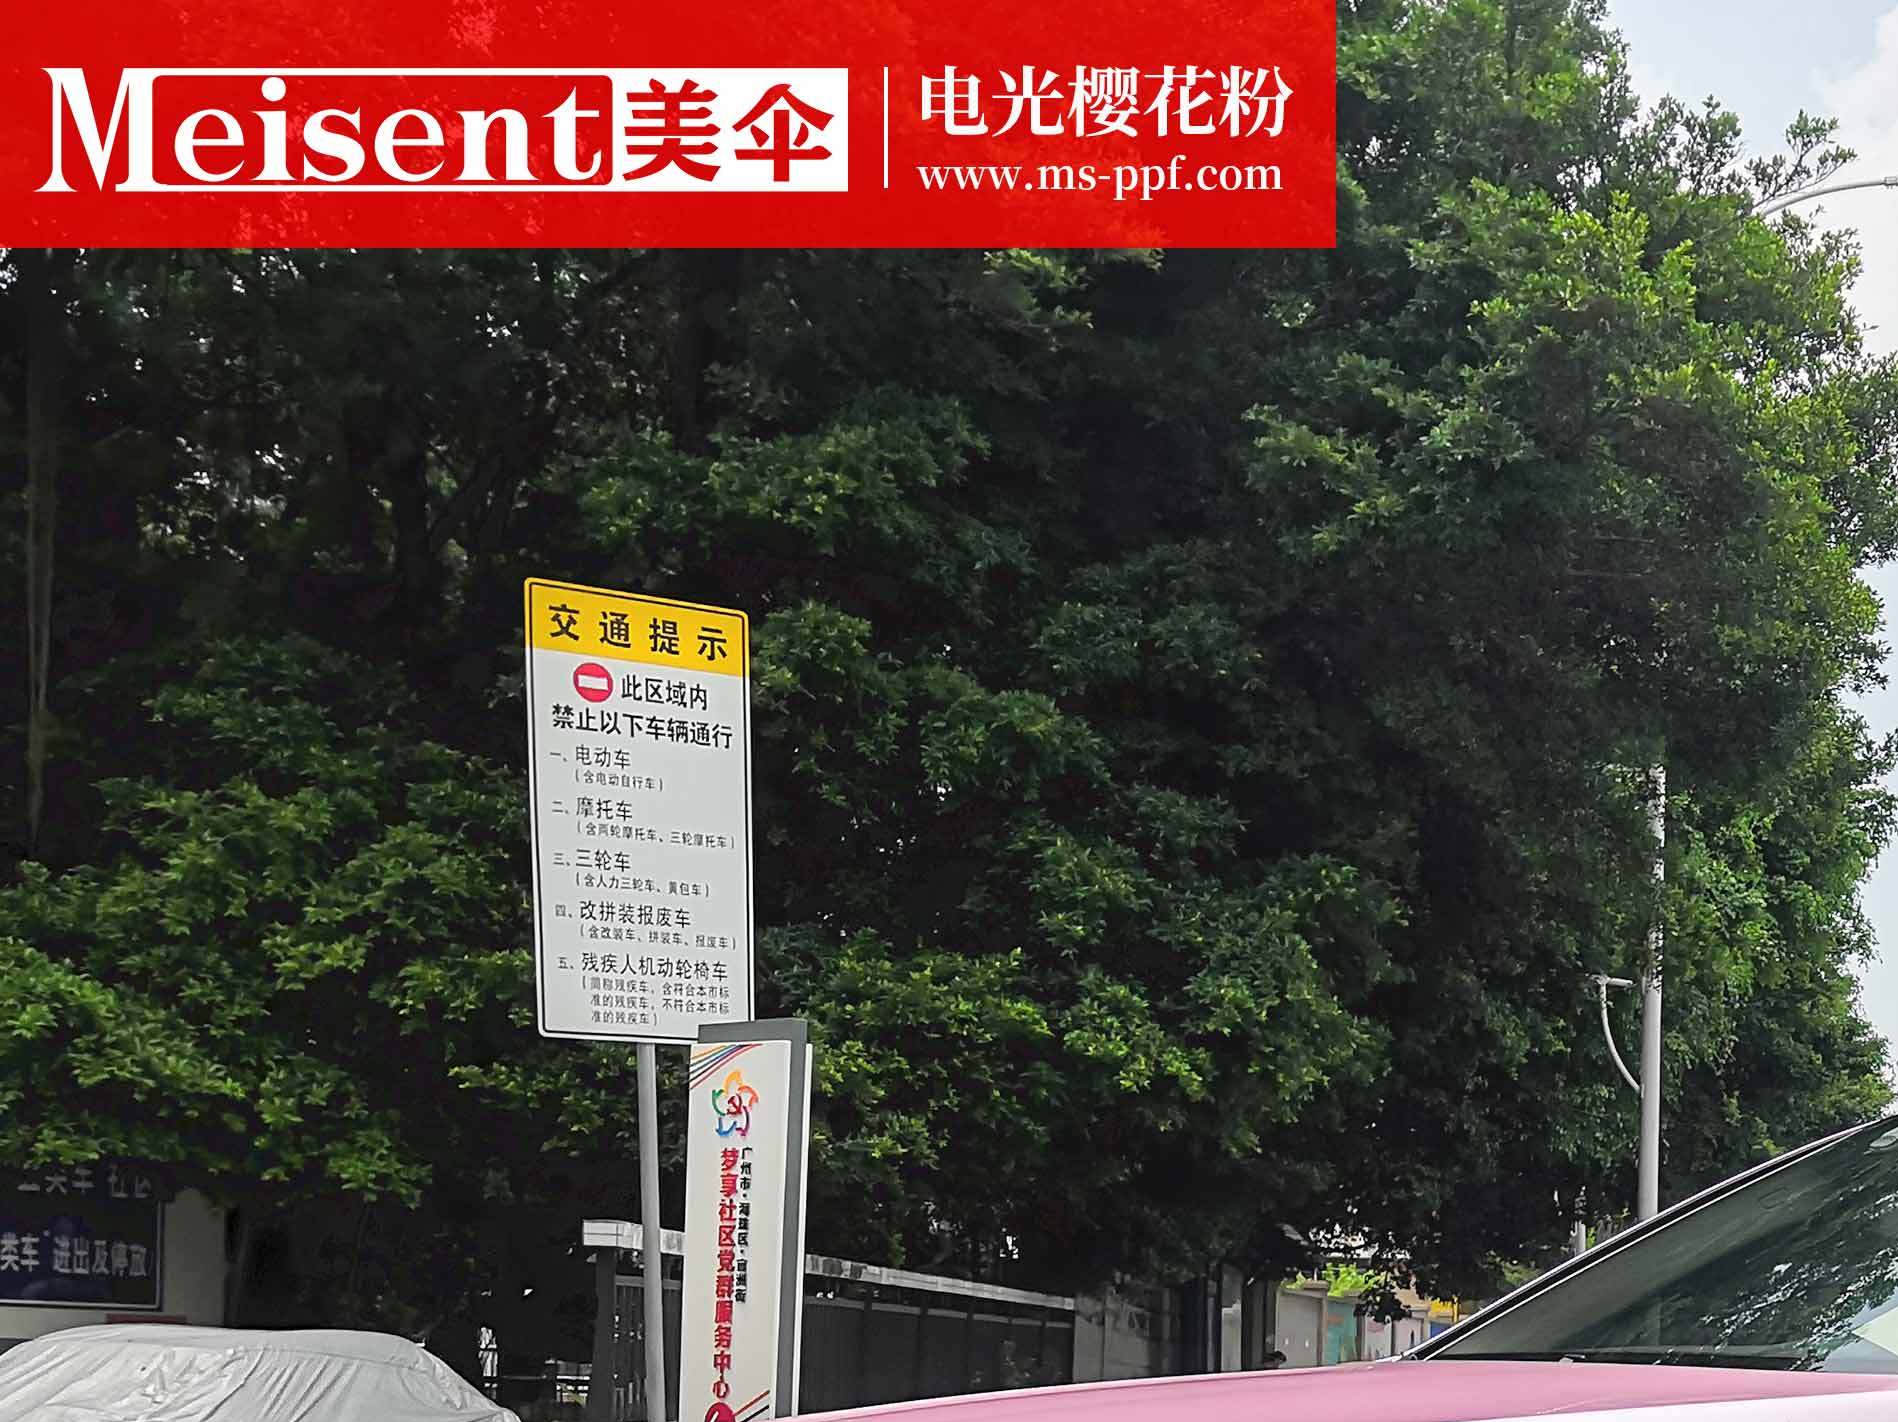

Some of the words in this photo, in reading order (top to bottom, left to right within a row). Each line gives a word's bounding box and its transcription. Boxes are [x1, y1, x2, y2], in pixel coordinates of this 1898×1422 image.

[548, 603, 728, 661] 交通提示
[621, 674, 708, 711] 此区域内
[552, 703, 733, 749] 禁止以下车辆通行
[712, 1147, 739, 1399] 梦享社区党群服务中心
